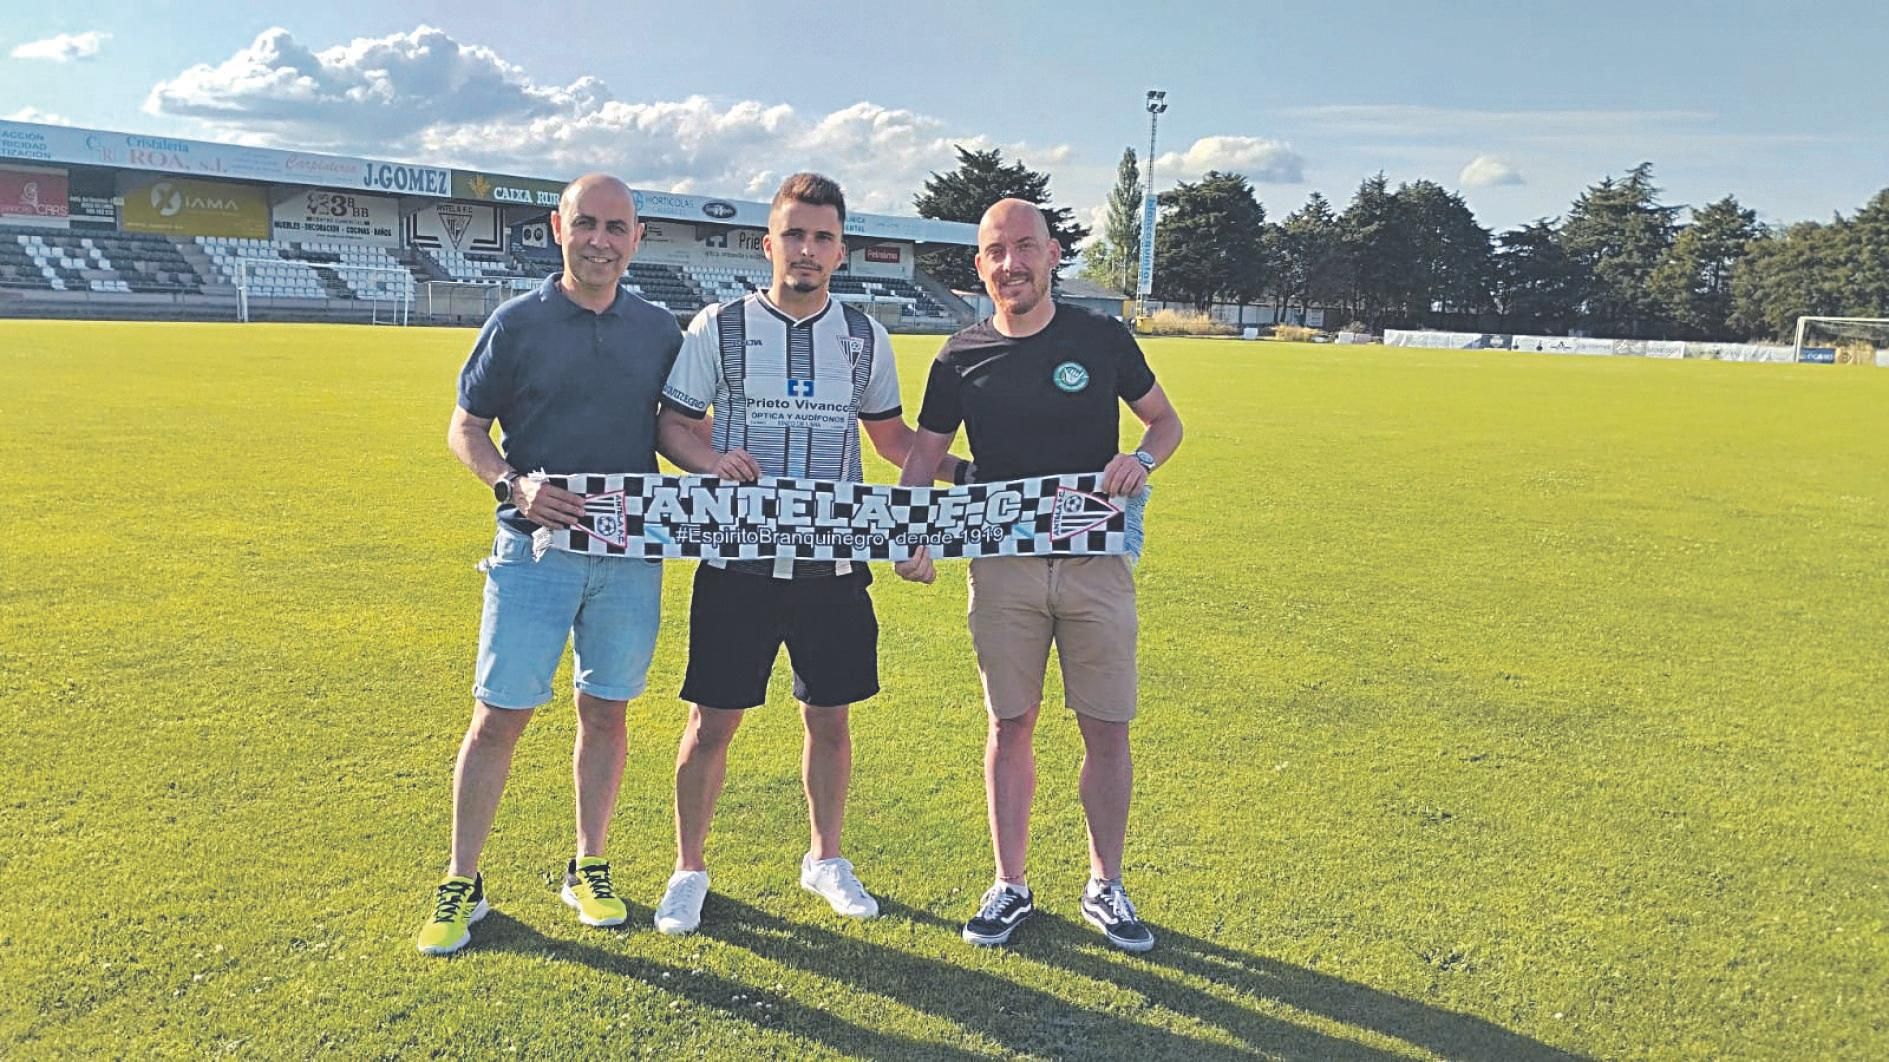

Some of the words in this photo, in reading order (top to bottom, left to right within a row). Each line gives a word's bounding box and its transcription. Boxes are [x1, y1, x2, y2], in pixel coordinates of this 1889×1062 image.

[363, 163, 447, 194] J.GOMEZ
[493, 186, 533, 203] CAIXA
[746, 398, 790, 409] Prieto
[644, 484, 896, 529] ANTELA
[895, 530, 953, 545] dende
[961, 526, 1005, 544] 1919
